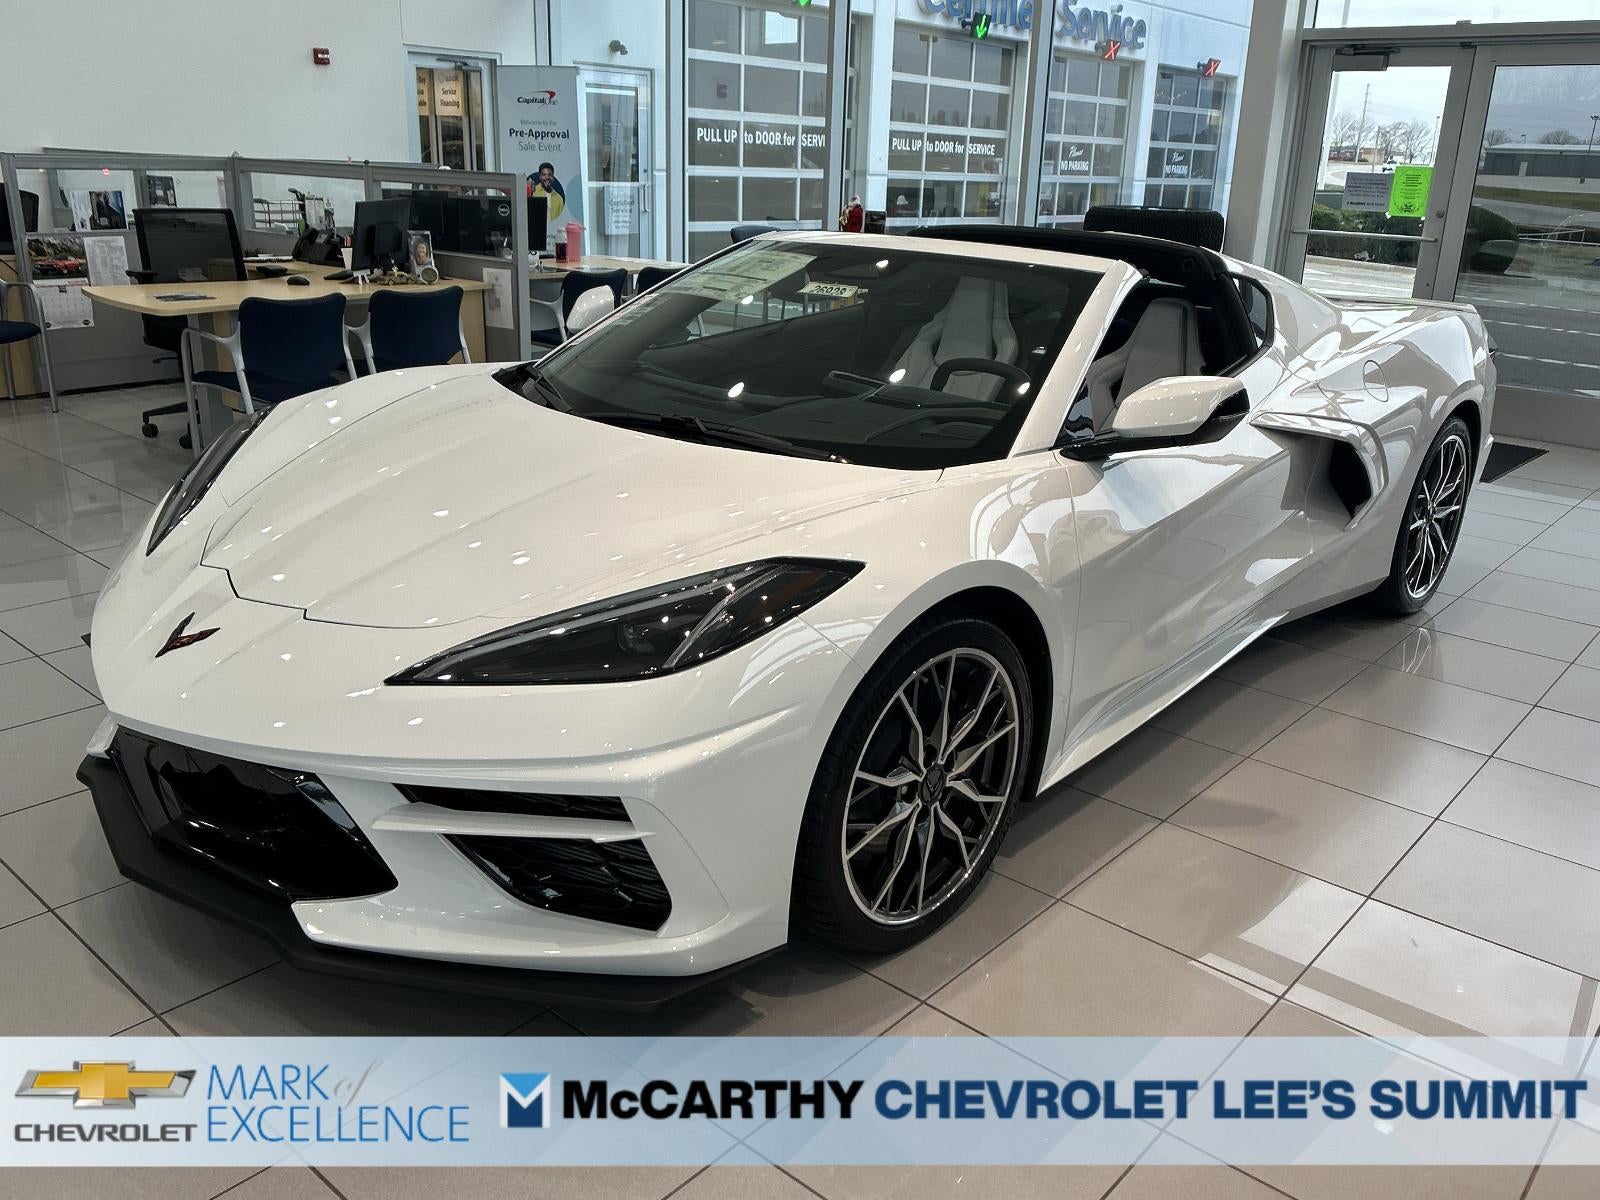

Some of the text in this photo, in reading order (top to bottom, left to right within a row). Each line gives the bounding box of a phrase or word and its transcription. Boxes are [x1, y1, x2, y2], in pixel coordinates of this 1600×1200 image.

[1060, 0, 1147, 49] Service
[509, 128, 570, 141] Pre-Approval
[696, 127, 826, 148] PULL UP to DOOR for SERVI
[518, 141, 562, 152] Sale Event
[892, 137, 995, 156] PULL UP to DOOR for SERVICE
[1061, 160, 1089, 171] NO PARKING
